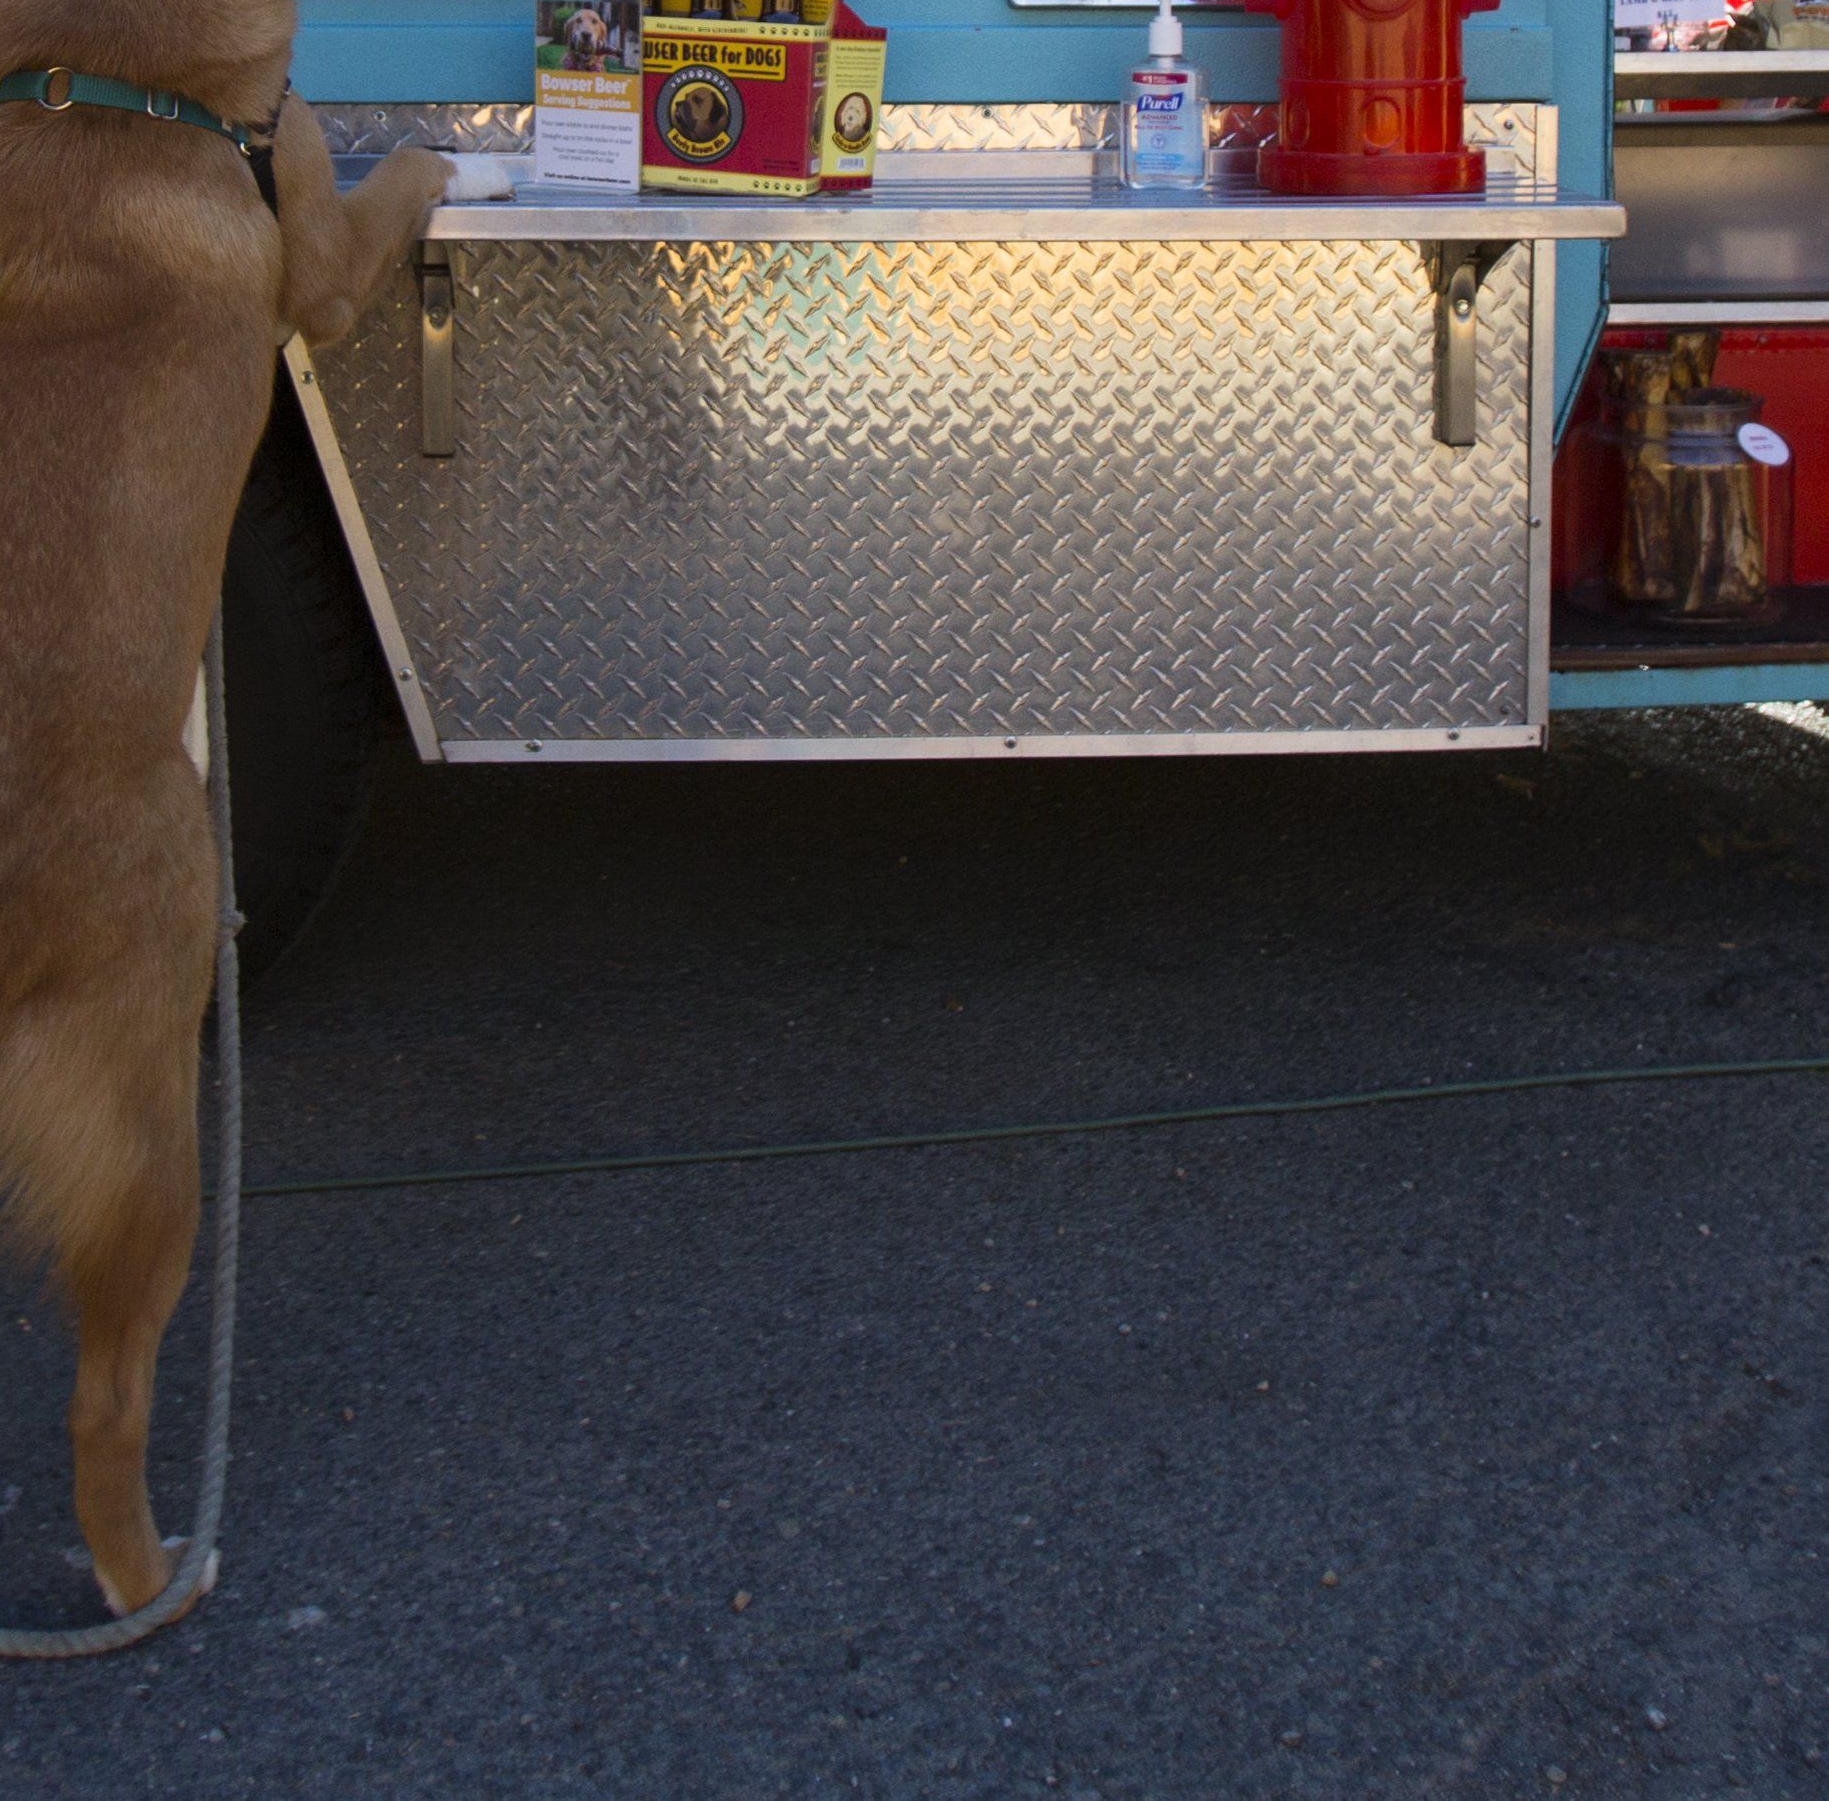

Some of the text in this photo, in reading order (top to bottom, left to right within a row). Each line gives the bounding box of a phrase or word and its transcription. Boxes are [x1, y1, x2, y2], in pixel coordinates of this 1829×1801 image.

[682, 44, 717, 64] BEER
[721, 47, 742, 66] for
[746, 48, 781, 68] DOGS
[540, 73, 593, 93] Bowser
[542, 93, 632, 110] Serving Suggestions
[1141, 95, 1179, 110] Purell
